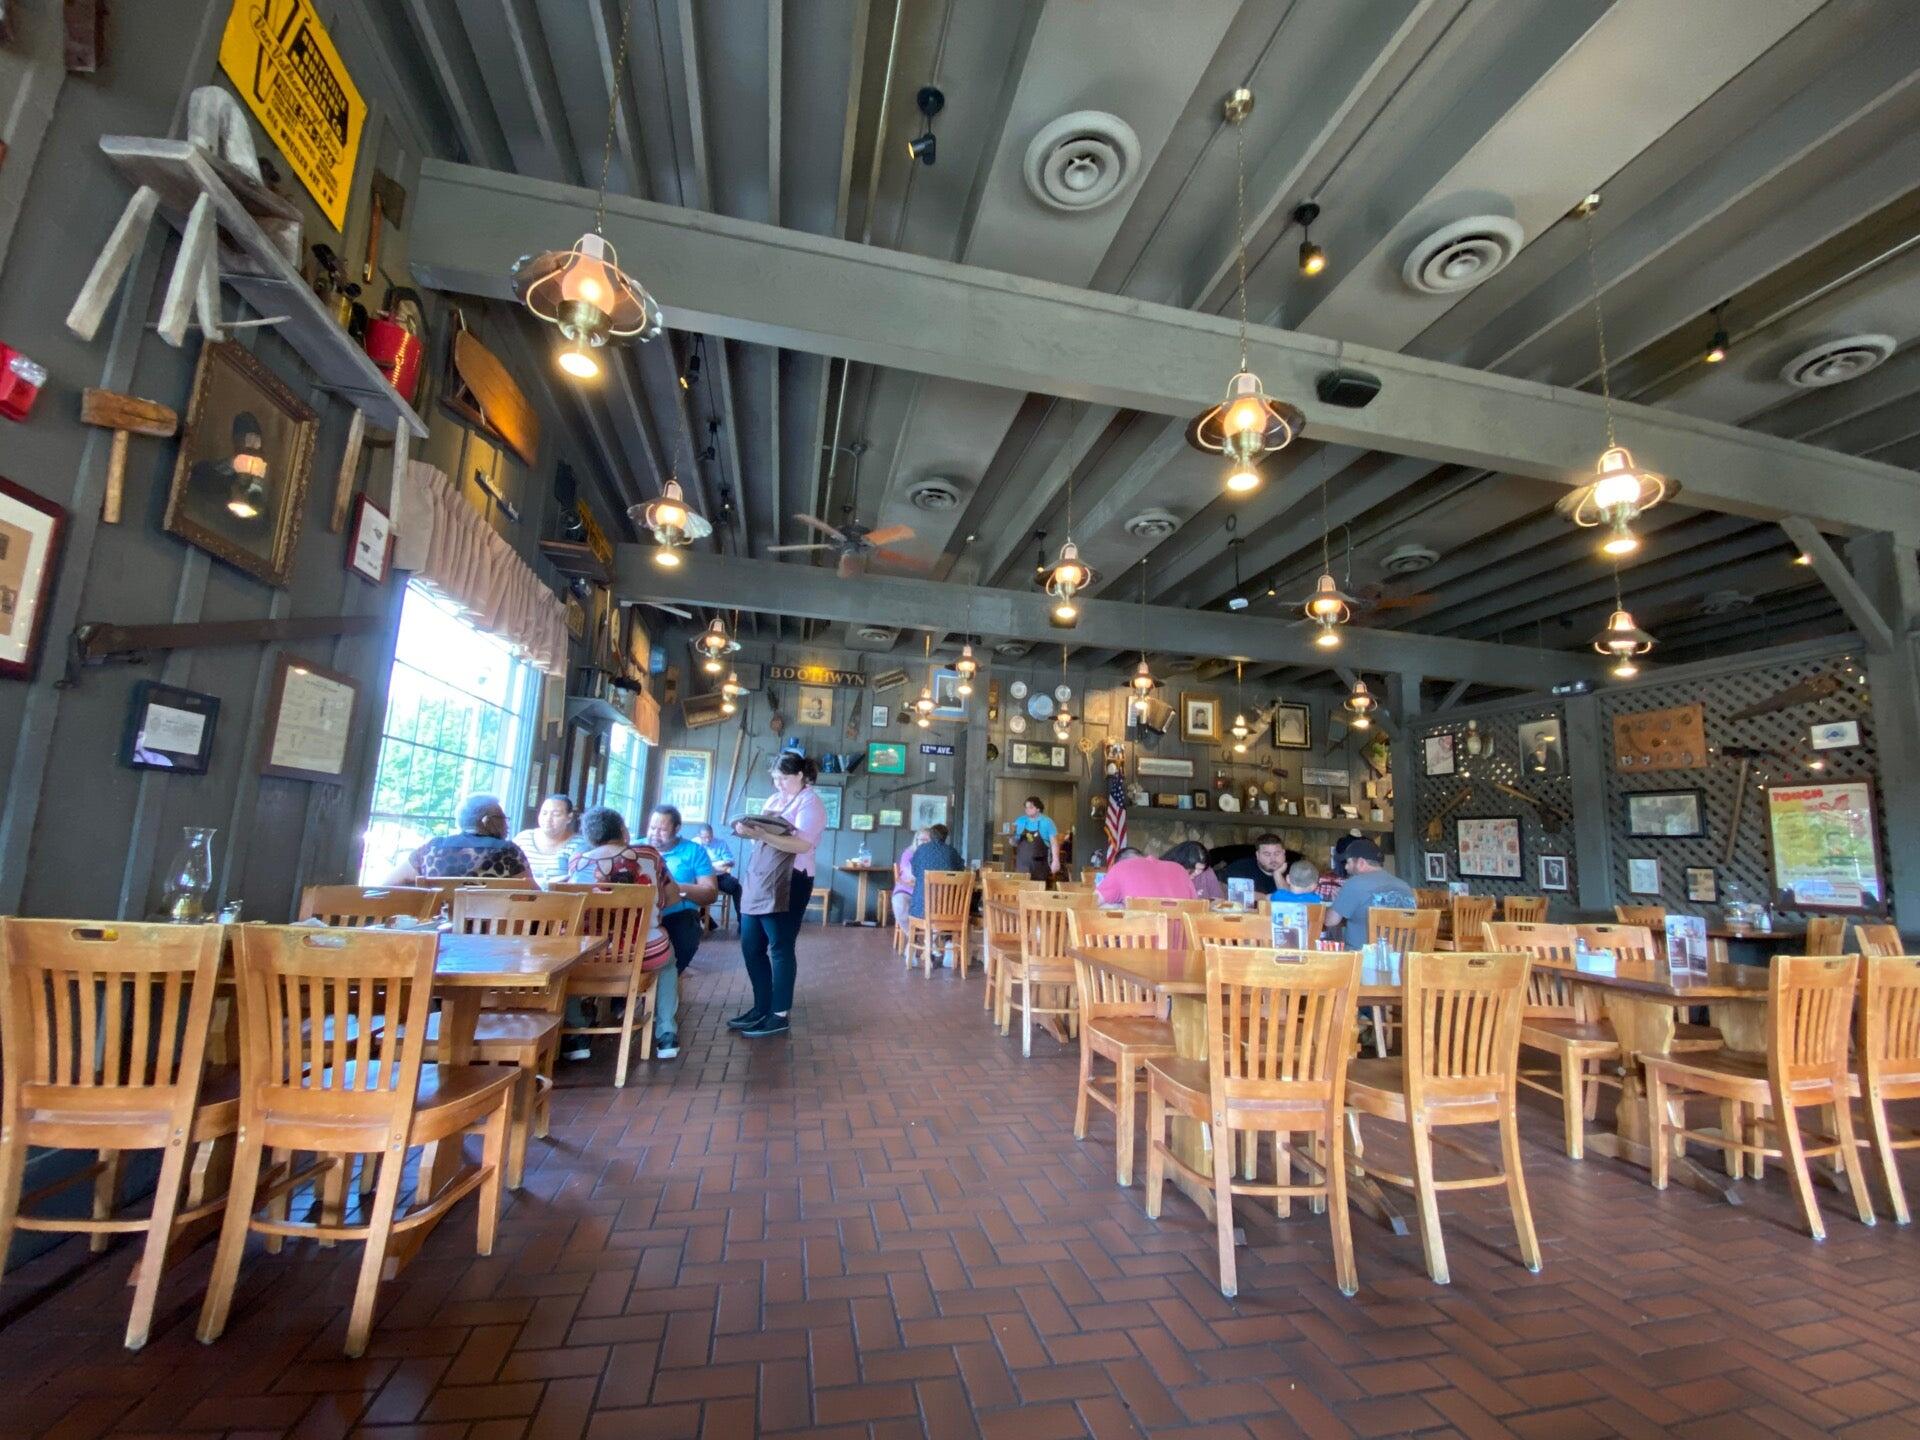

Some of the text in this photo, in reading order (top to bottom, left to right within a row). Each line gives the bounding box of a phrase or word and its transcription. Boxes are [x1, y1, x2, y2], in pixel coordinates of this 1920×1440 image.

[250, 14, 277, 50] Van
[288, 50, 332, 122] MATERIAL
[299, 30, 346, 112] HUNTSVILLE
[301, 50, 340, 118] BUILDING
[937, 746, 953, 755] AVE.
